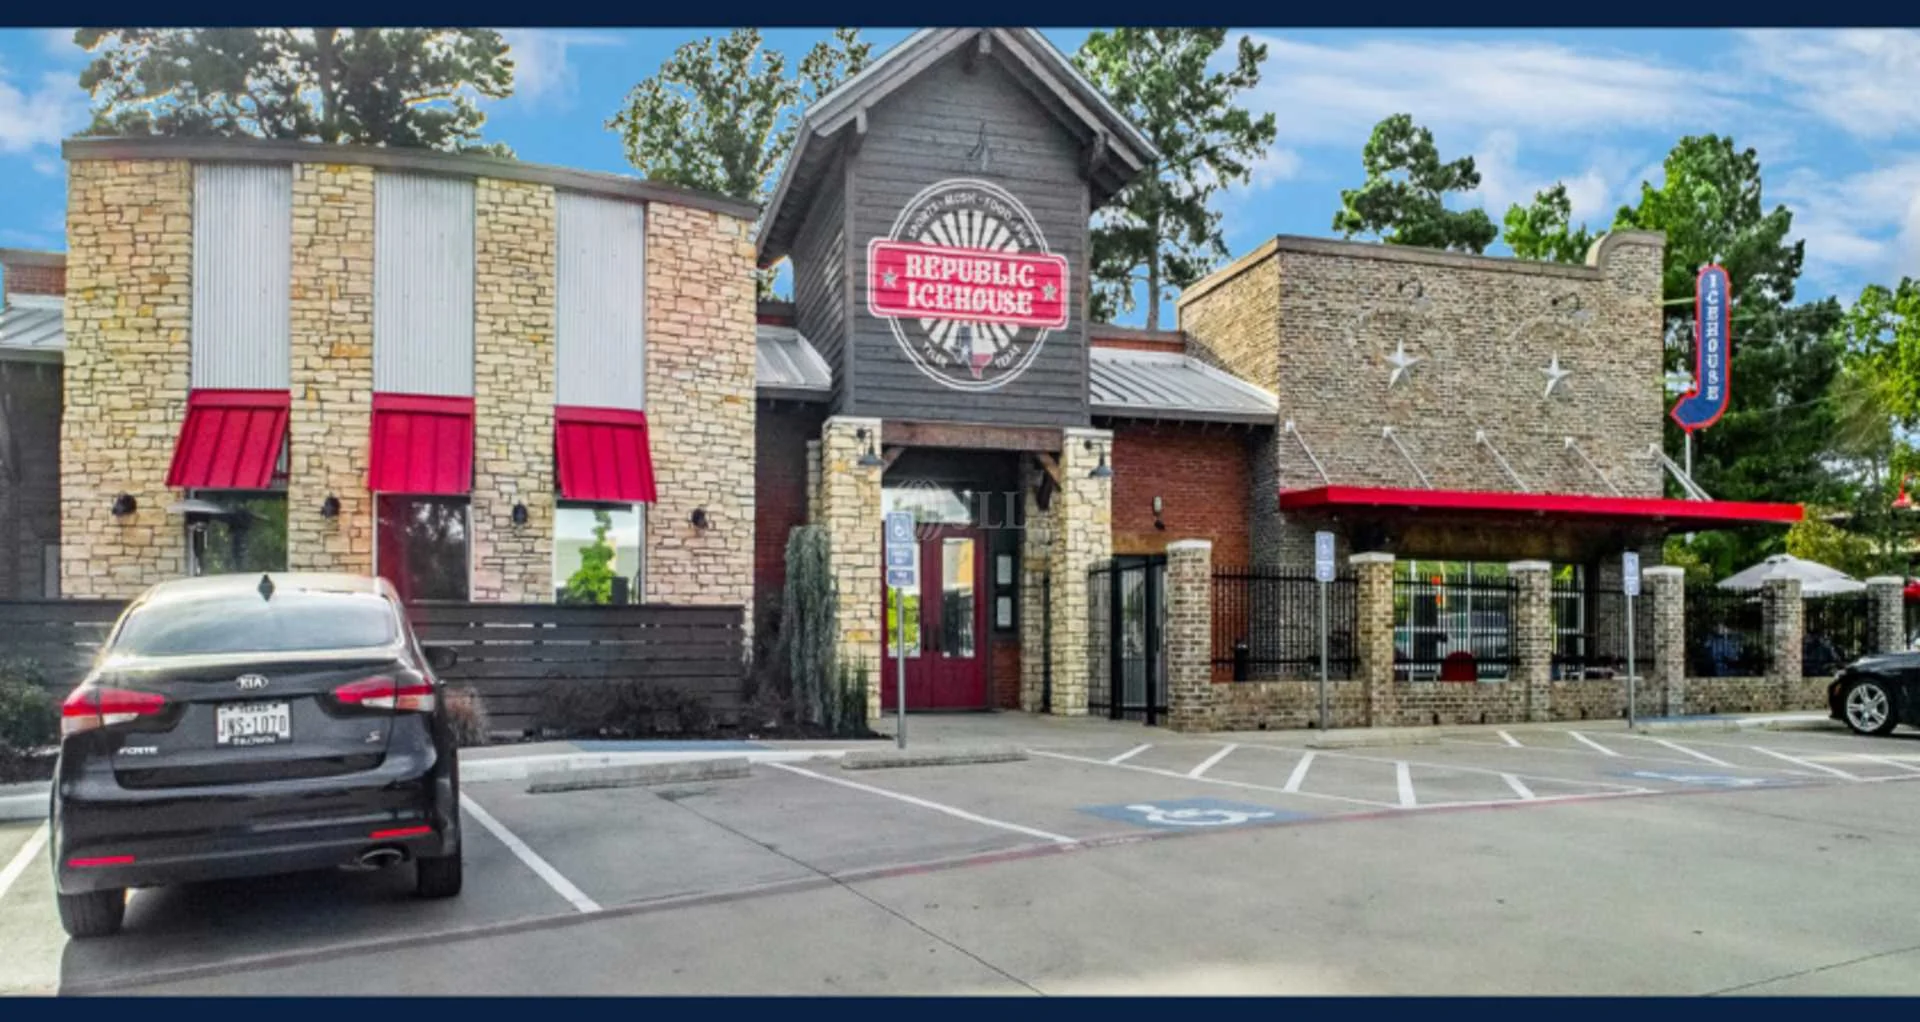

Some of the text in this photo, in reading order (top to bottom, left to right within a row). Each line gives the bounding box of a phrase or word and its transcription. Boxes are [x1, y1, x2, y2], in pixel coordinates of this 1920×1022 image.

[983, 196, 1012, 221] FOOD
[905, 254, 1035, 288] REPUBLIC
[906, 281, 1033, 316] ICEHOUSE
[1705, 274, 1719, 401] ICEHOUSE
[994, 344, 1021, 368] TEXAS
[239, 677, 262, 689] KIA
[118, 746, 159, 756] FORTE
